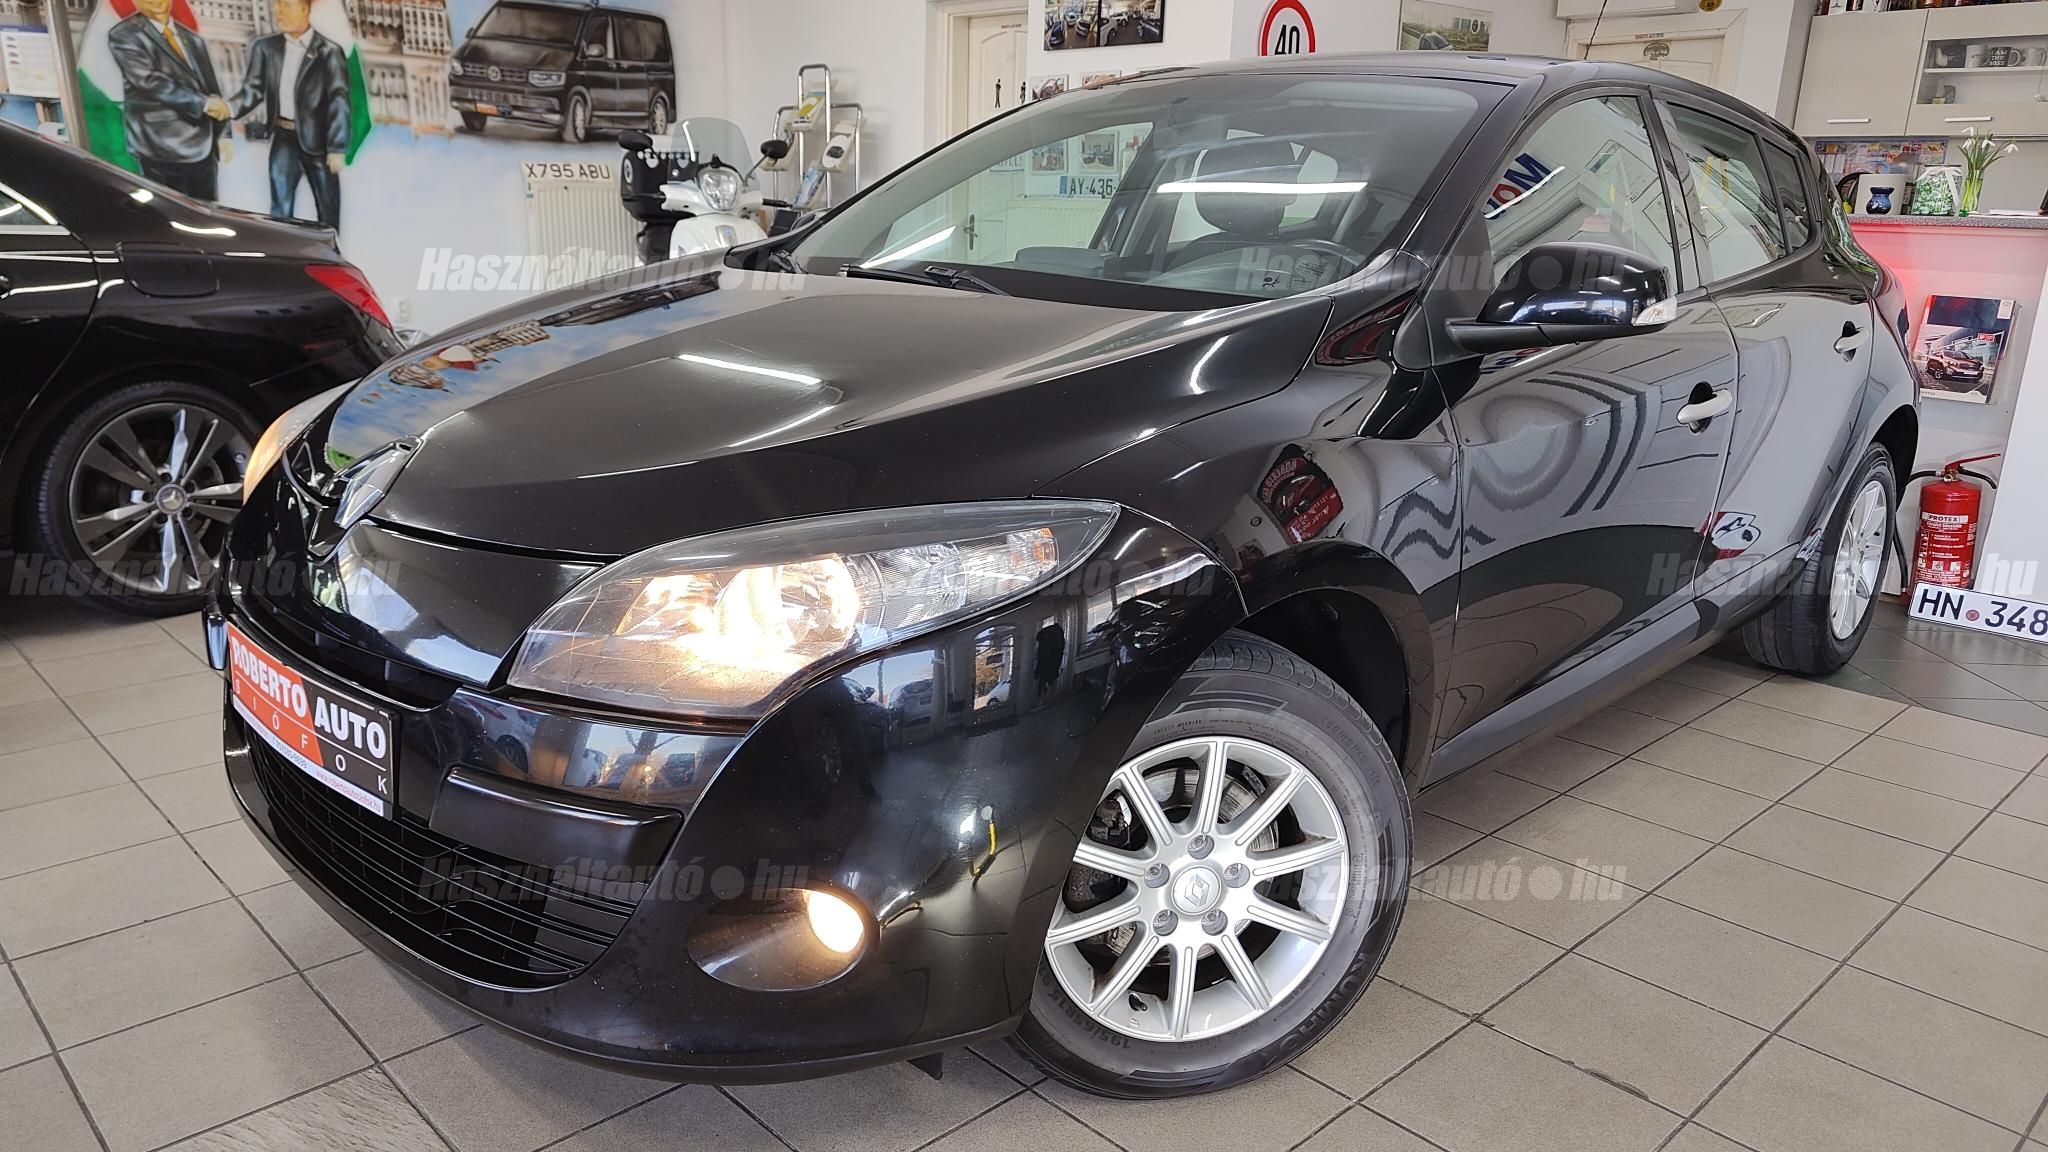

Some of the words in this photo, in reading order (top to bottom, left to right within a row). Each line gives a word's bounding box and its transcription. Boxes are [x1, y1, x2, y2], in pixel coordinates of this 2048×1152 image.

[1275, 24, 1300, 55] 40
[525, 163, 574, 178] X795
[579, 164, 610, 179] ABU
[1928, 514, 1958, 522] PROTEX
[1918, 589, 1964, 620] HN
[1984, 601, 2048, 636] 348
[231, 636, 307, 718] ROBERTO
[314, 696, 387, 759] AUTO
